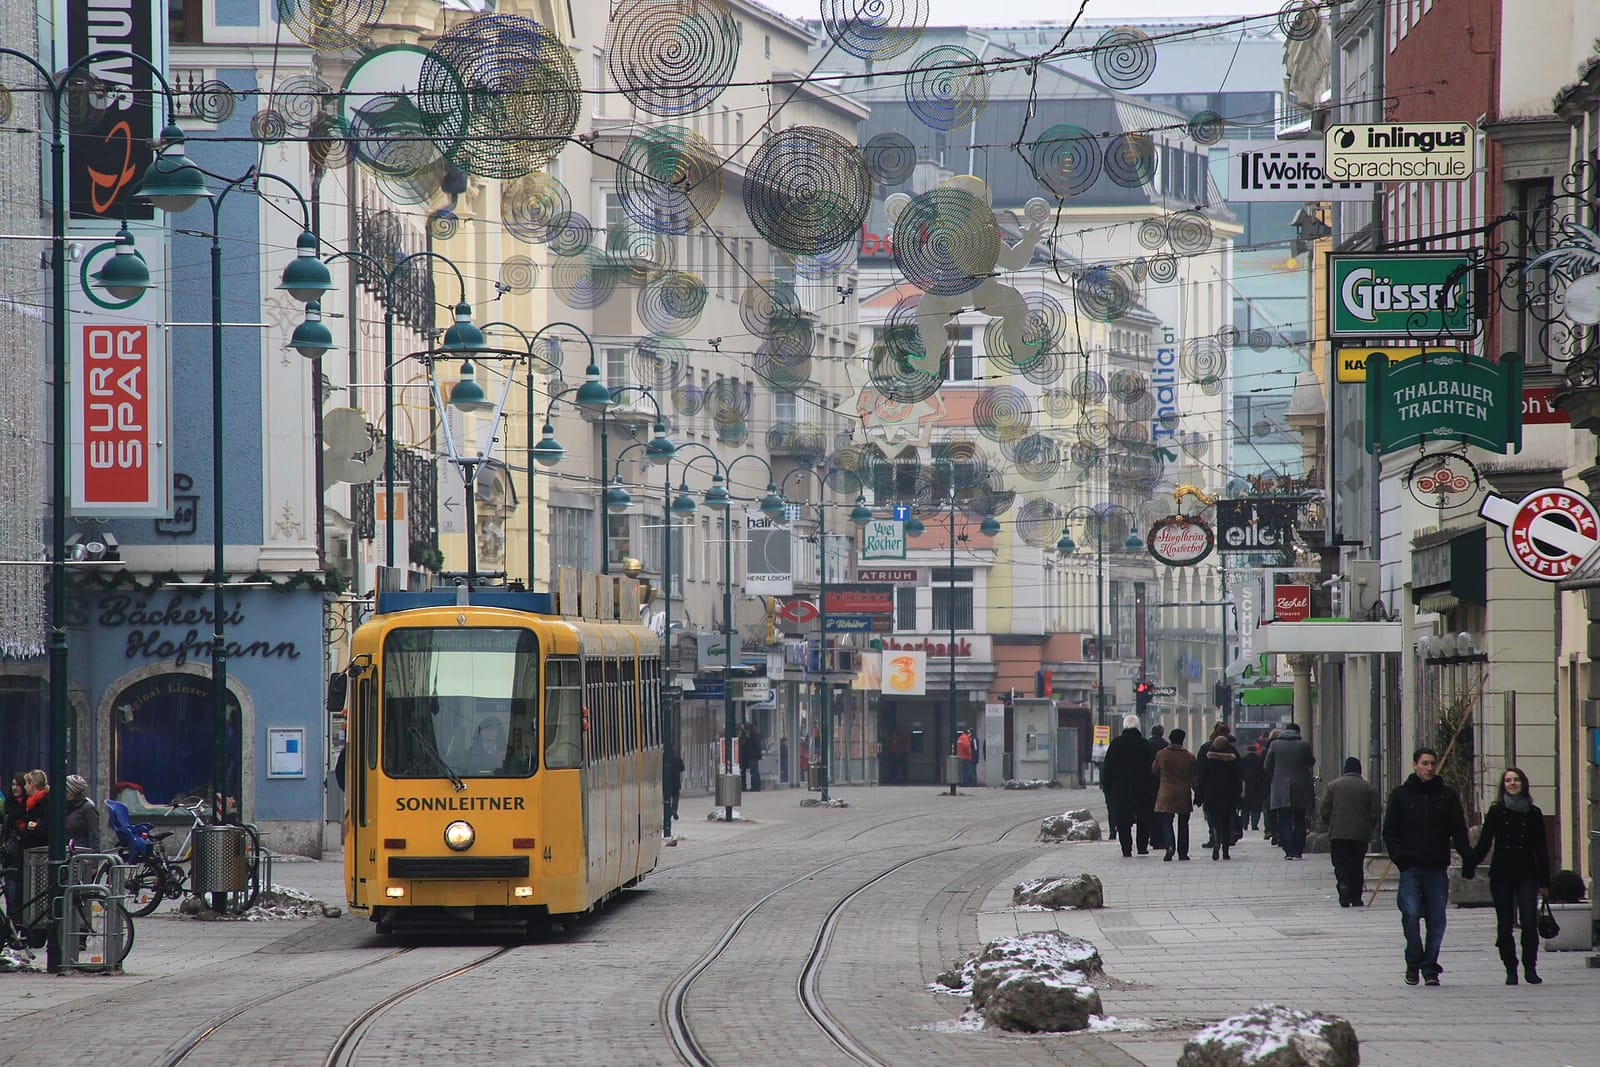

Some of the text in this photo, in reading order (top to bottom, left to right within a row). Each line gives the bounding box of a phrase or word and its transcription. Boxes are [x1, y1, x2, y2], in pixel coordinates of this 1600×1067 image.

[88, 0, 134, 111] SATU
[1367, 126, 1466, 153] inlingua
[1262, 161, 1326, 181] Wolfo
[1333, 156, 1466, 181] Sprachschule
[89, 330, 114, 468] EURO
[117, 329, 143, 468] SPAR
[1393, 380, 1495, 407] THALBAUER
[1398, 400, 1488, 422] TRACHTEN
[1527, 496, 1595, 530] TABAK
[865, 535, 902, 552] Rocher
[874, 523, 895, 538] Yves
[1514, 527, 1575, 575] TRAFIK
[861, 571, 912, 580] ATRIUM
[98, 594, 245, 627] Bäckerei
[1242, 586, 1253, 661] SCHUHE
[125, 629, 300, 666] Hofmann
[891, 656, 916, 691] 3
[396, 796, 525, 811] SONNLEITNER
